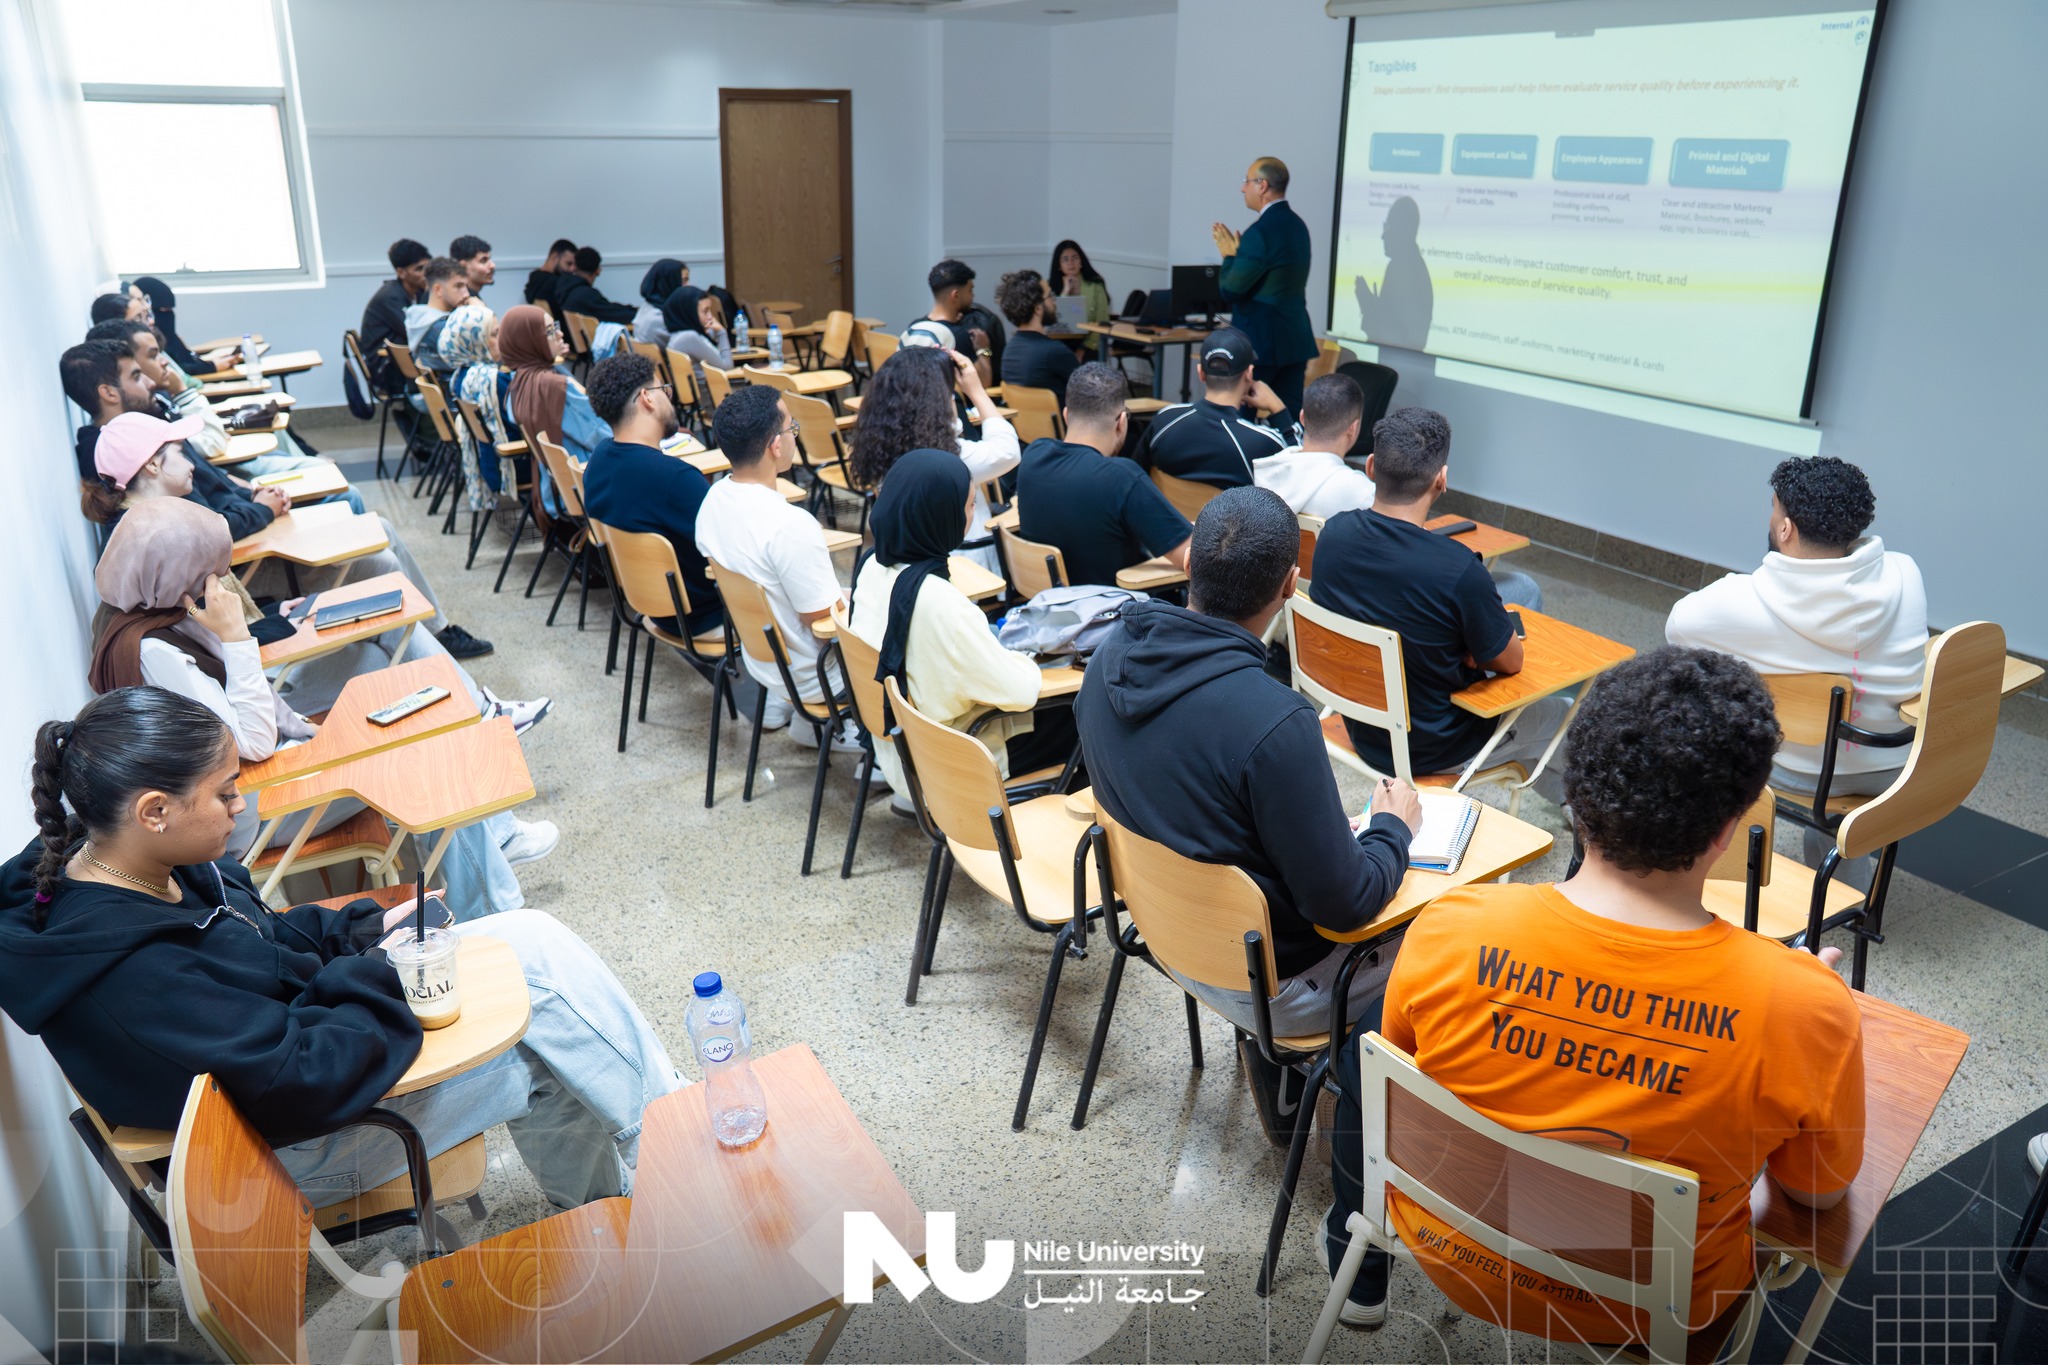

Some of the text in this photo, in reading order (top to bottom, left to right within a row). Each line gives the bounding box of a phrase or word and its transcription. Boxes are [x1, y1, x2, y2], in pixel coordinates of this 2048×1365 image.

[1820, 20, 1853, 31] Internal
[1368, 60, 1417, 76] Tangibles
[1452, 83, 1498, 95] impressions
[1500, 82, 1516, 93] and
[1519, 82, 1536, 95] help
[1538, 82, 1560, 93] them
[1563, 80, 1601, 93] evaluate
[1604, 81, 1637, 92] service
[1639, 78, 1674, 94] quality
[1676, 77, 1711, 91] before
[1713, 76, 1787, 93] experiencing
[1788, 75, 1800, 89] it.
[1460, 149, 1528, 160] Equipment and Tools
[1561, 153, 1644, 167] Employee Appearance
[1688, 150, 1770, 165] Printed and Digital
[1705, 164, 1747, 176] Materials
[1662, 198, 1772, 215] Clear and attractive Marketing
[1660, 210, 1766, 228] Material, Brochures, website,
[1697, 225, 1727, 236] business
[1426, 246, 1464, 261] elements
[1465, 250, 1511, 266] collectively
[1513, 256, 1544, 270] impact
[1545, 260, 1589, 275] customer
[1591, 264, 1633, 282] comfort,
[1636, 270, 1664, 285] trust,
[1667, 273, 1688, 287] and
[1453, 269, 1482, 281] overall
[1483, 272, 1530, 288] perception
[1531, 277, 1542, 289] of
[1543, 280, 1576, 294] service
[1452, 326, 1468, 336] ATM
[1468, 329, 1501, 344] condition,
[1504, 335, 1520, 345] staff
[1520, 339, 1556, 353] uniforms,
[1557, 344, 1596, 361] marketing
[1597, 351, 1632, 366] material
[1633, 357, 1641, 367] &
[1642, 360, 1665, 373] cards
[404, 980, 454, 999] OCIAL
[1477, 945, 1740, 1042] WHAT YOU THINK
[702, 1042, 734, 1055] ELANO
[1490, 1011, 1690, 1095] YOU BECAME
[1417, 1225, 1450, 1252] WHAT
[1452, 1243, 1477, 1264] YOU
[1510, 1270, 1538, 1290] YOU
